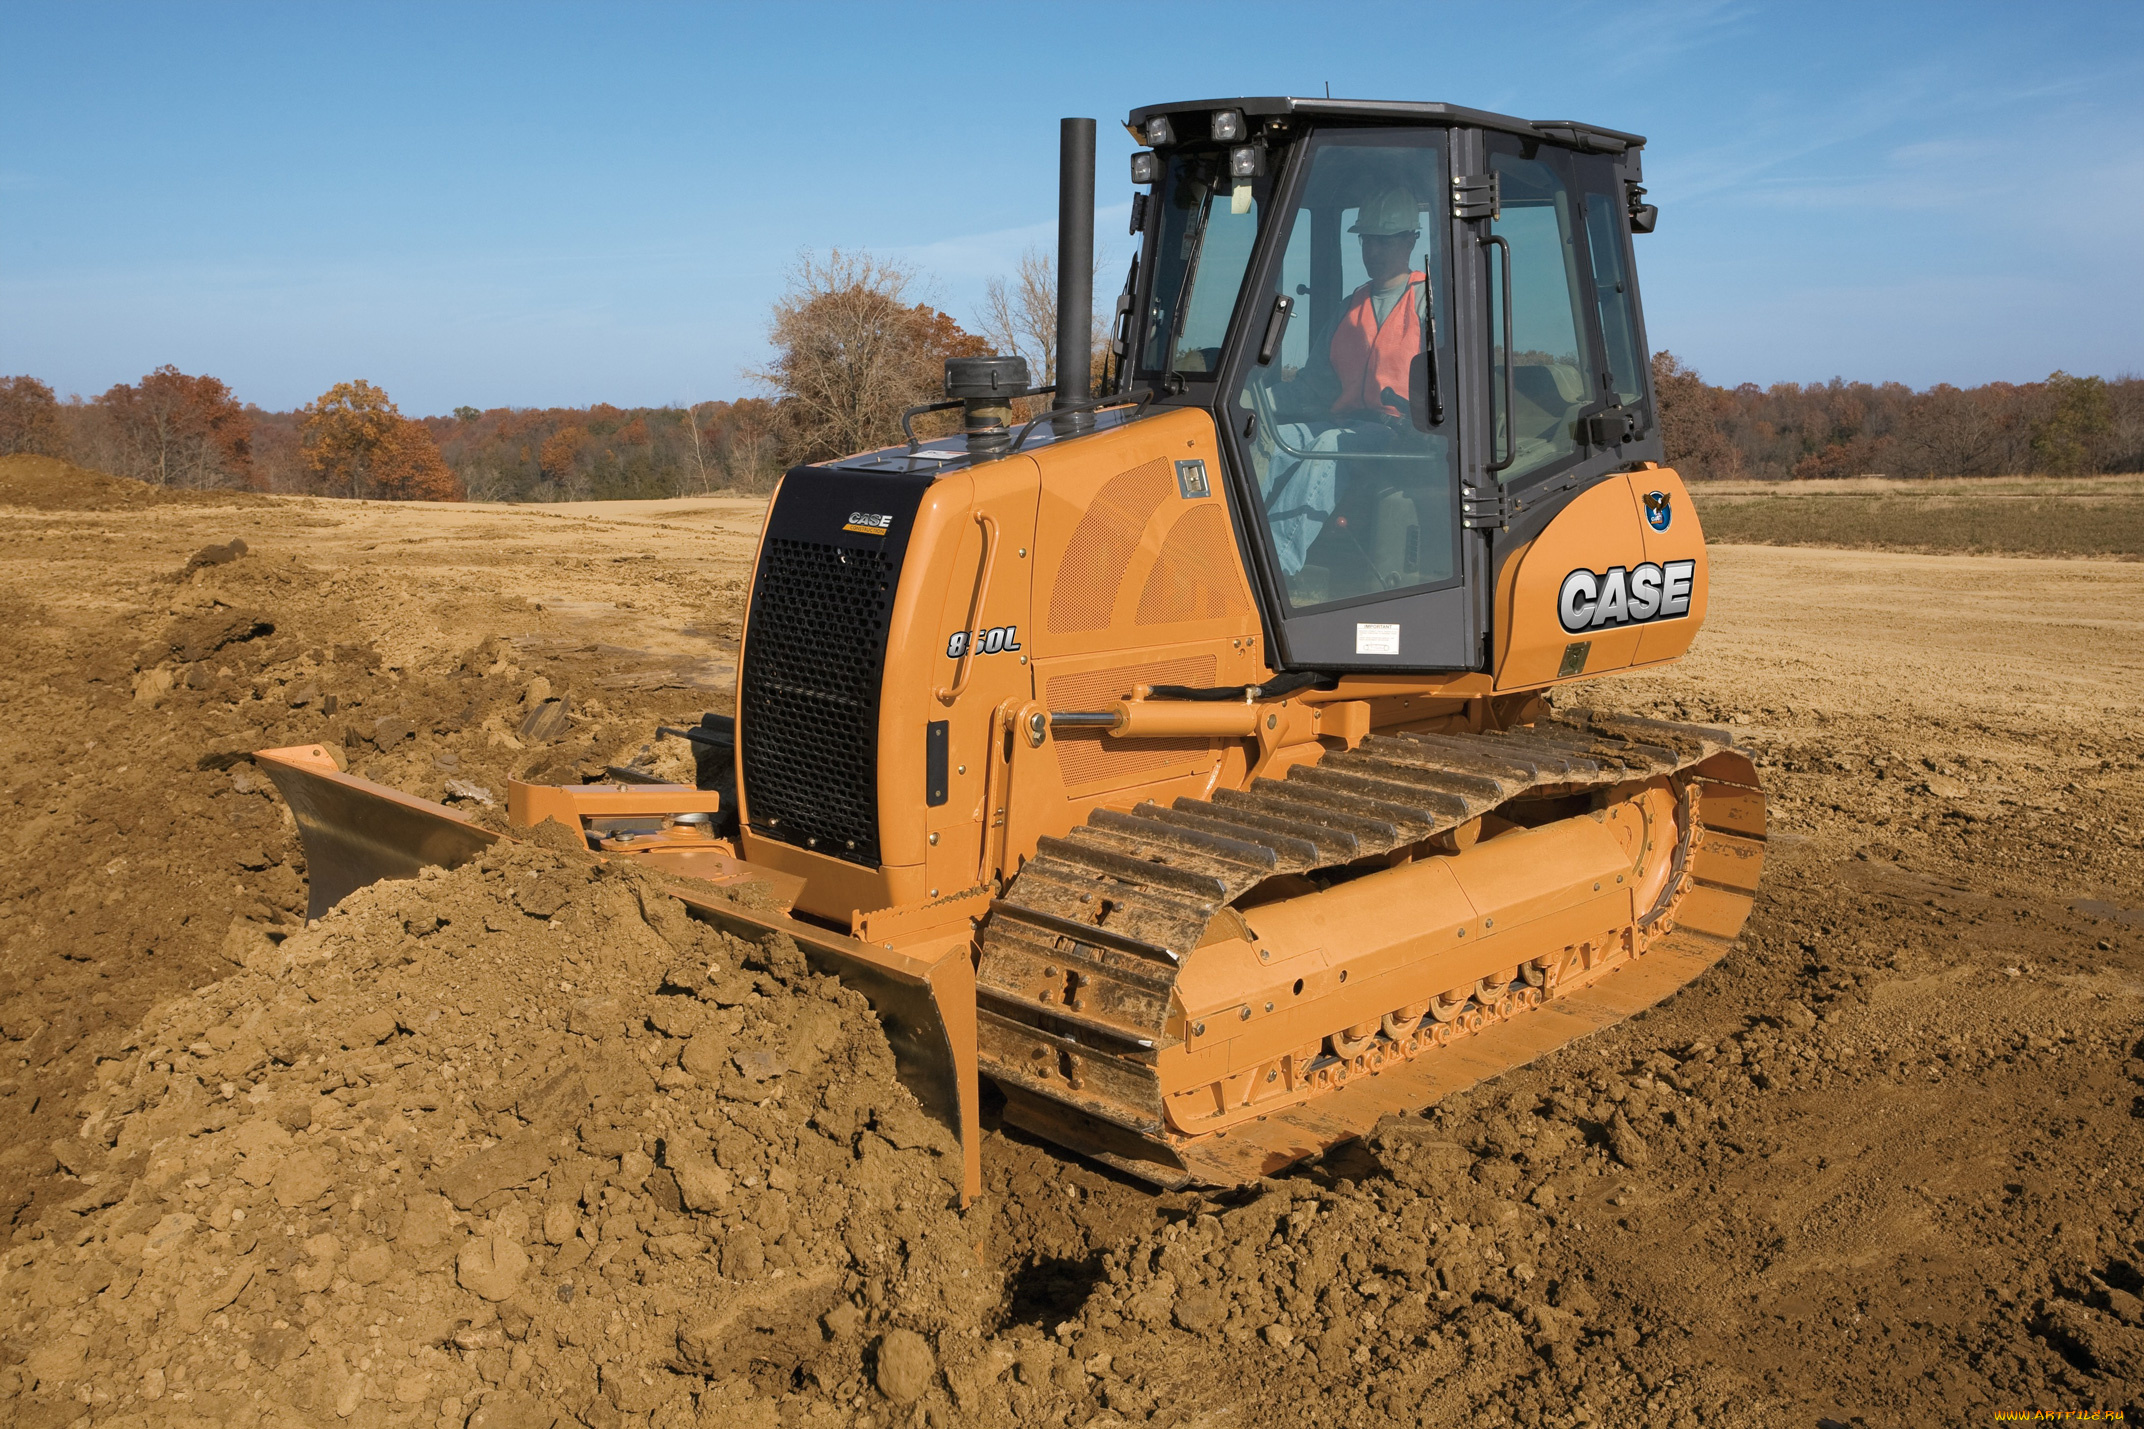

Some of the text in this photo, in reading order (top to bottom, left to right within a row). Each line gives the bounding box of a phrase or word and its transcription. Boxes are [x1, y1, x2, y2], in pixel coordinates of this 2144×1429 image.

[848, 511, 893, 528] CASE
[849, 525, 885, 534] CONSTRUCTION
[1557, 560, 1695, 633] CASE
